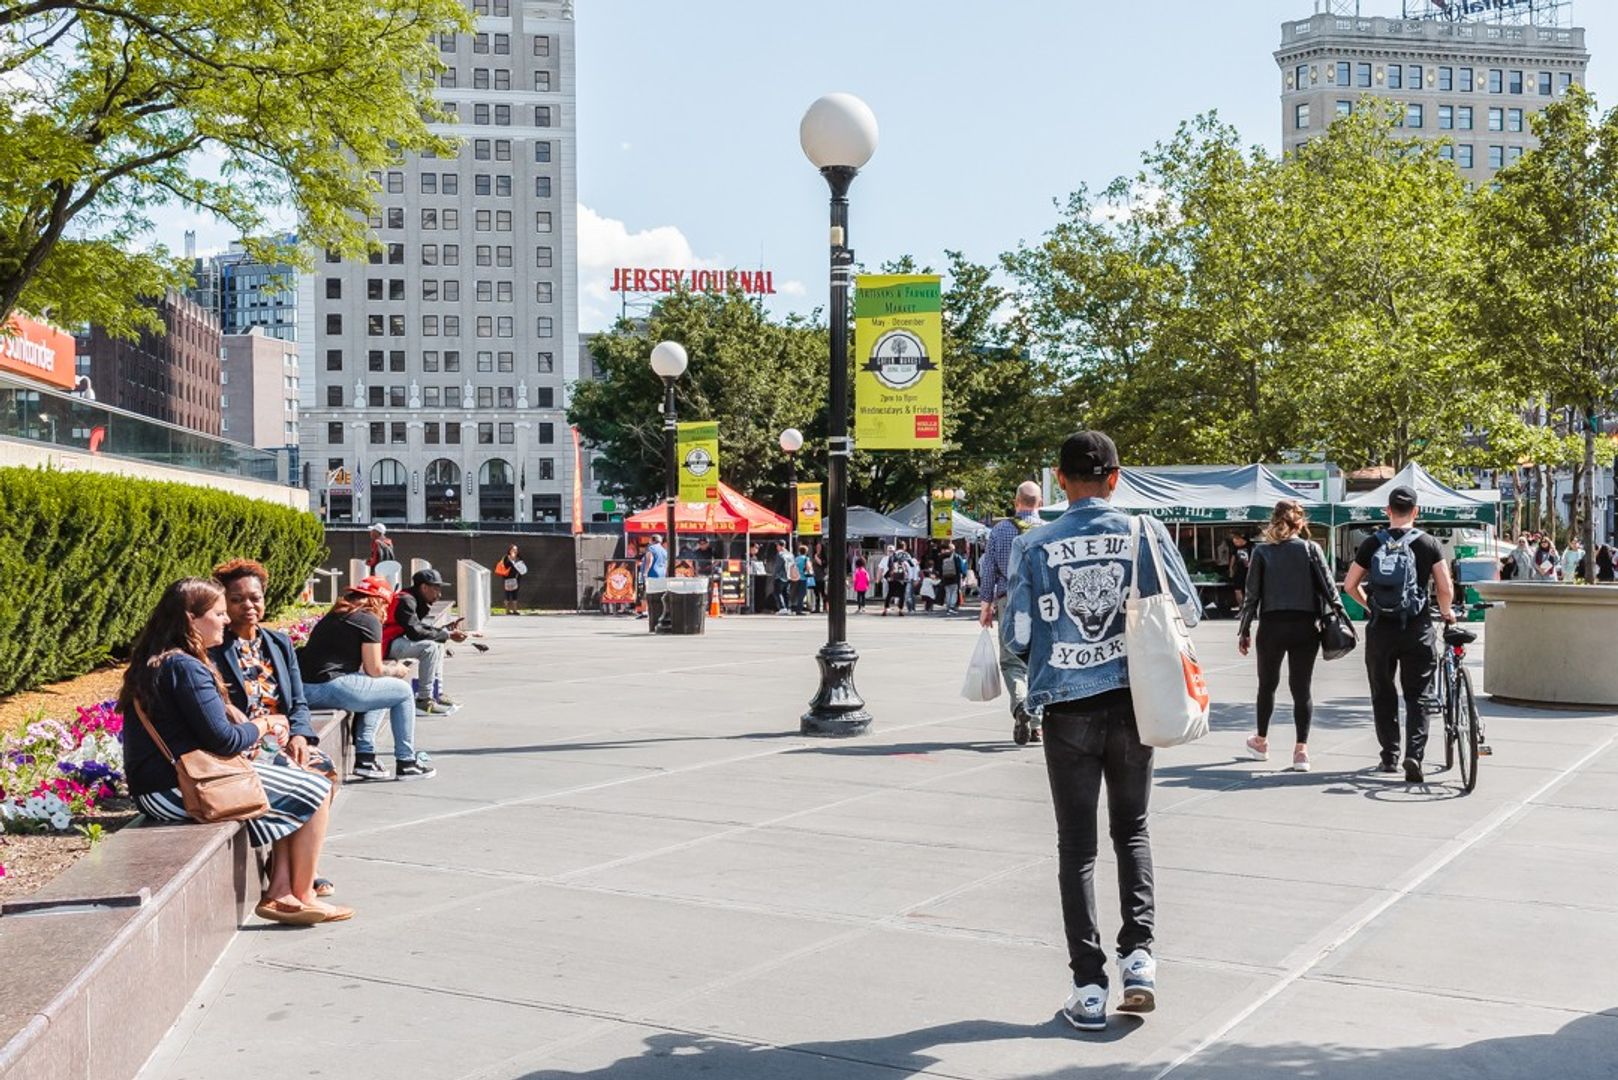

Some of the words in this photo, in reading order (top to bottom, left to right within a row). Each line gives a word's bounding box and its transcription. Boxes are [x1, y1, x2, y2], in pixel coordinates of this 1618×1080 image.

[610, 268, 685, 292] JERSEY
[689, 269, 777, 294] JOURNAL
[885, 301, 916, 313] MARKET
[872, 318, 885, 327] May
[892, 317, 925, 326] December
[860, 405, 903, 415] Wednesdays
[905, 404, 911, 414] &
[913, 404, 939, 415] Fridays
[1061, 536, 1126, 560] NEW
[1059, 640, 1121, 667] YORK
